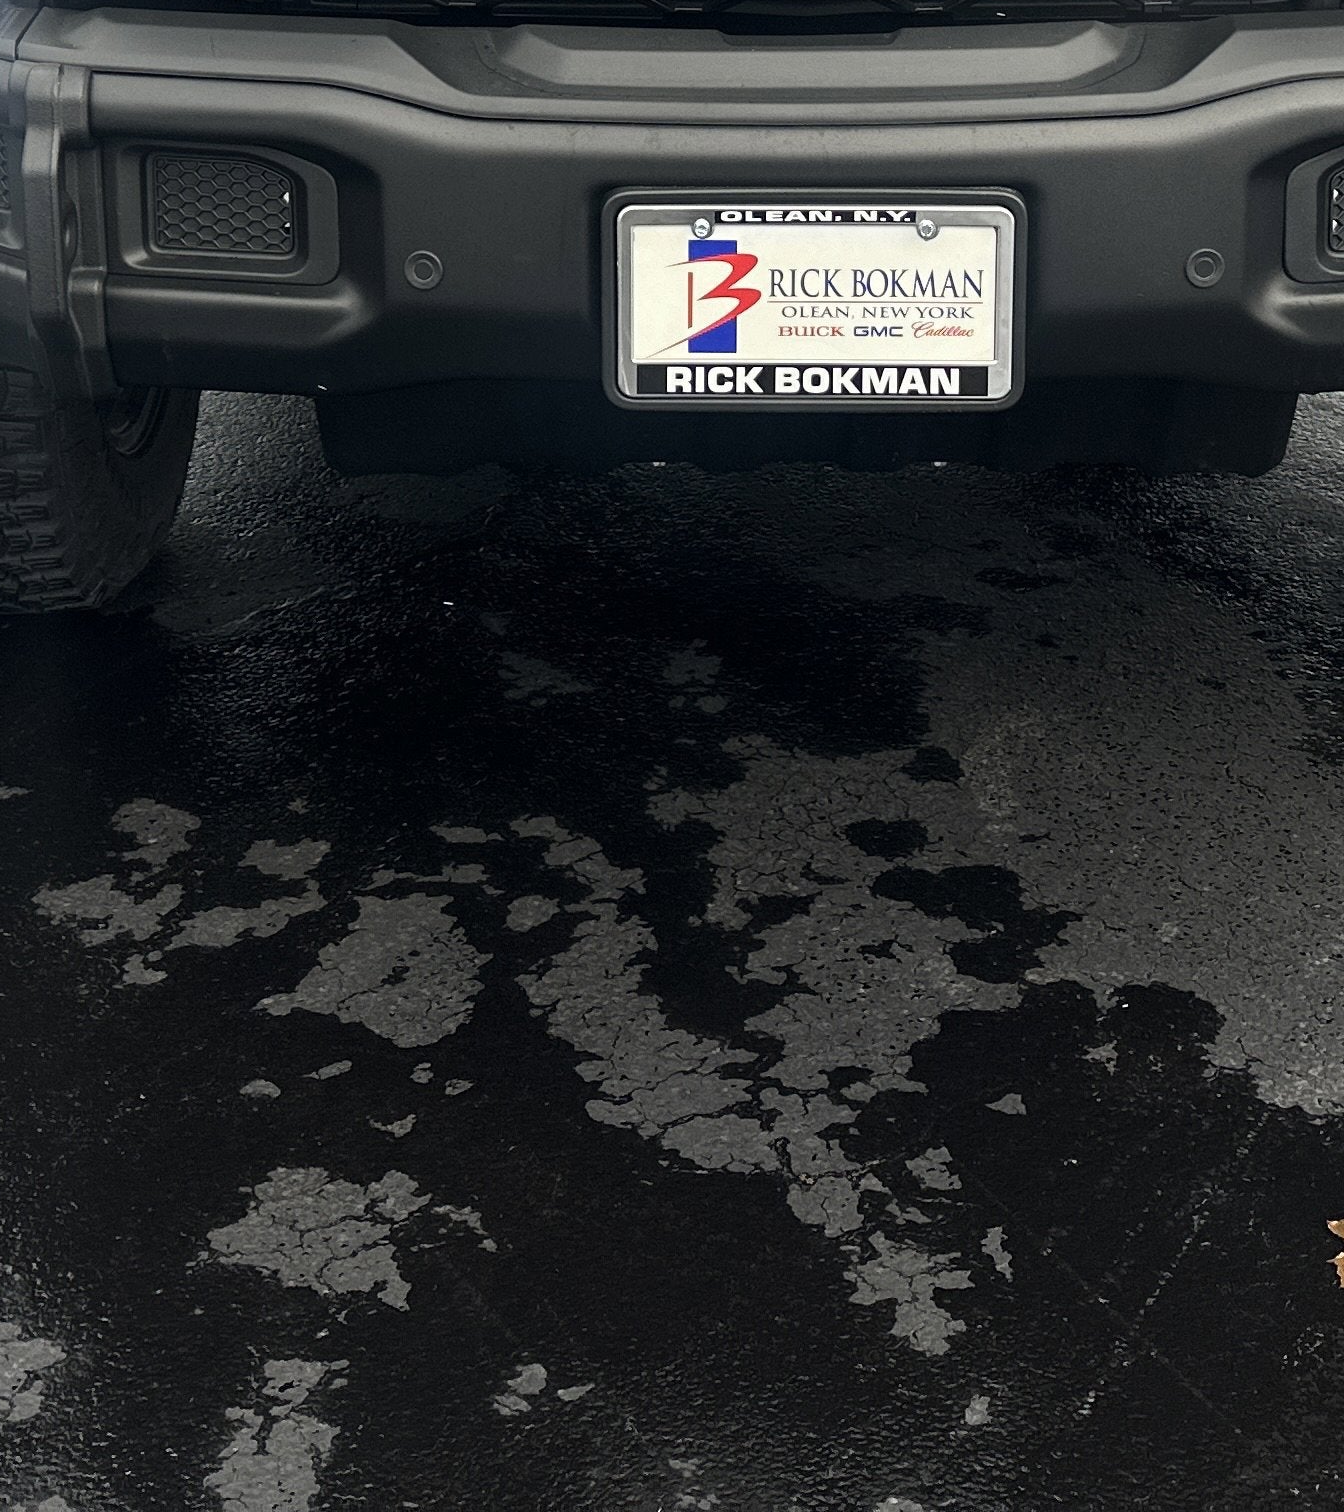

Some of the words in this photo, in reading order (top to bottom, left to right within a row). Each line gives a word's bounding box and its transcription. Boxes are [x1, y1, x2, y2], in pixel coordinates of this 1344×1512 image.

[720, 210, 842, 222] OLEAN,
[853, 210, 911, 222] N.Y.
[768, 268, 844, 298] RICK
[851, 268, 984, 299] BOKMAN
[781, 305, 855, 320] OLEAN,
[862, 306, 910, 319] NEW
[915, 306, 975, 319] YORK
[778, 326, 845, 337] BUICK
[853, 326, 904, 337] GMC
[911, 321, 975, 338] Cadillac
[666, 366, 765, 394] RICK
[774, 366, 960, 395] BOKMAN
